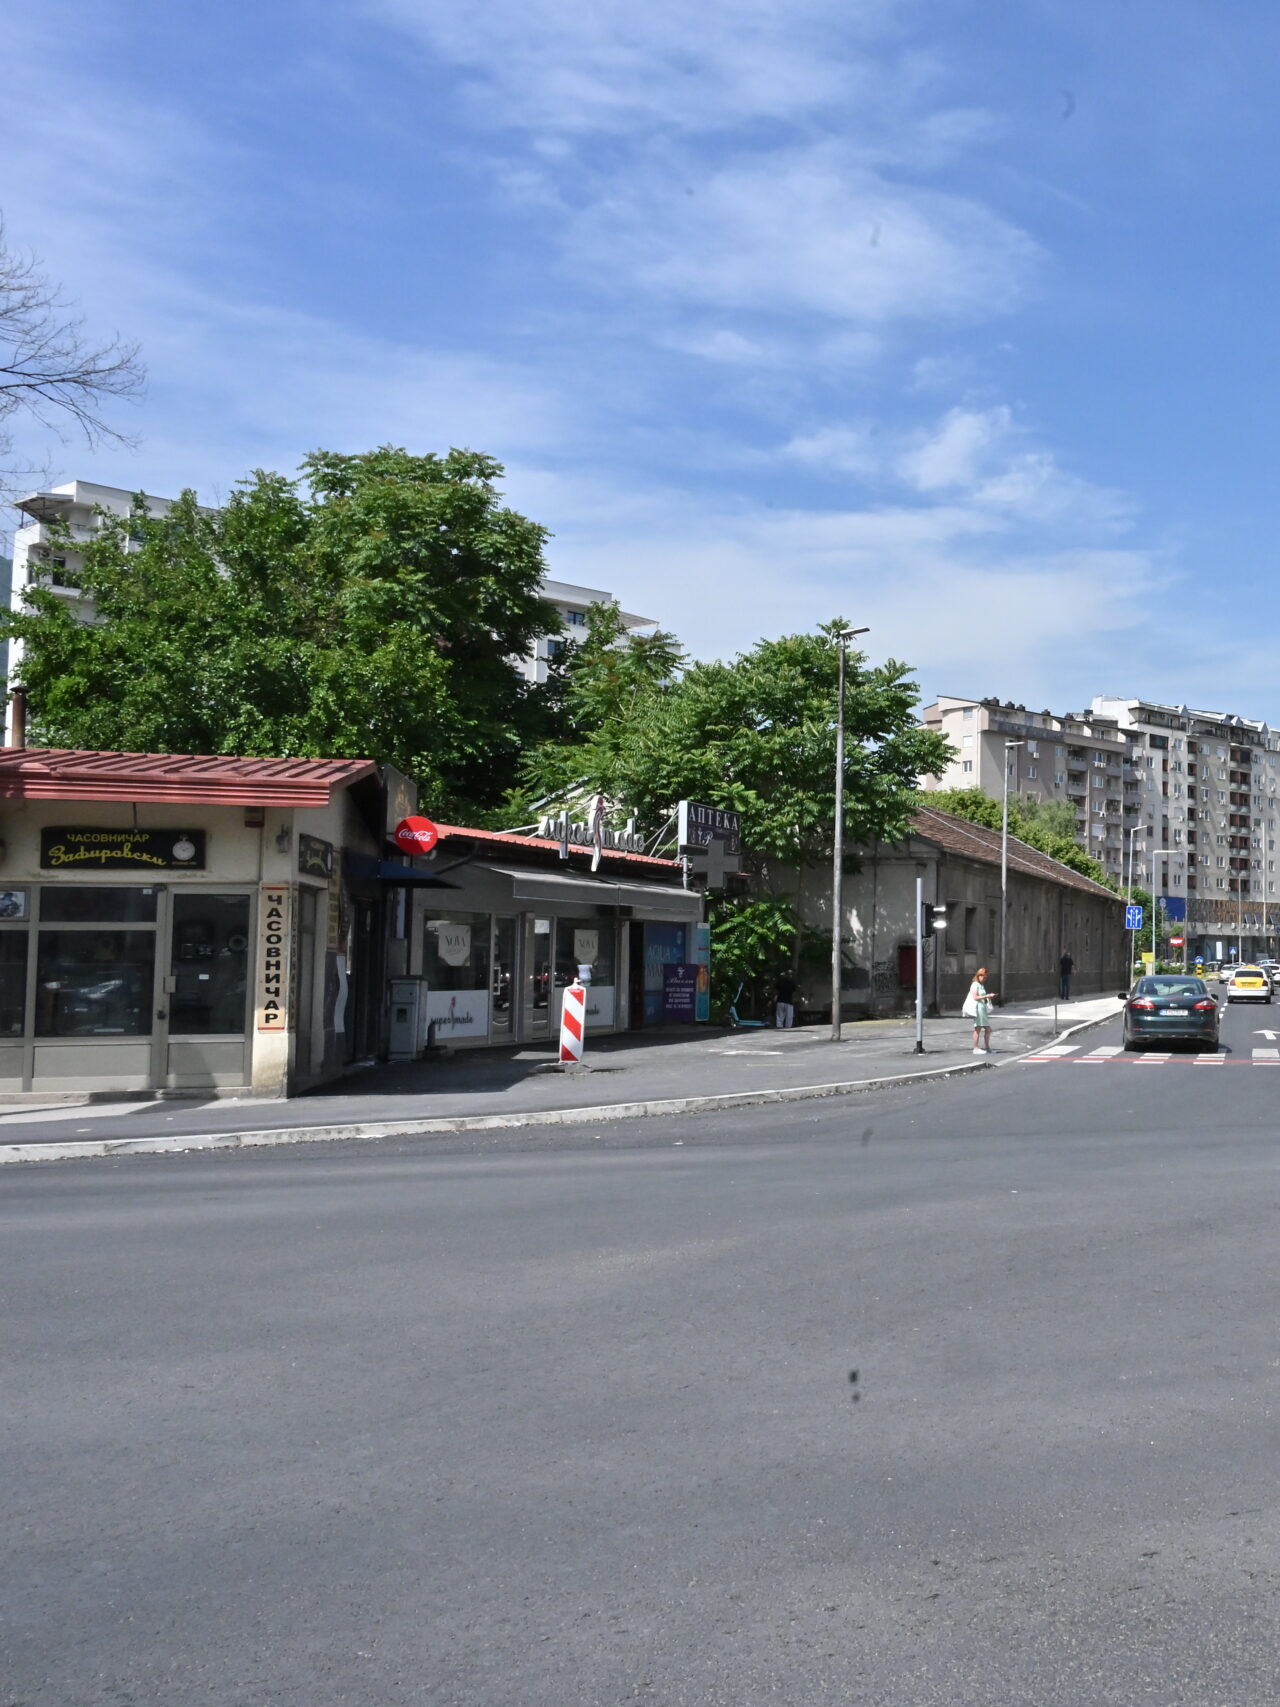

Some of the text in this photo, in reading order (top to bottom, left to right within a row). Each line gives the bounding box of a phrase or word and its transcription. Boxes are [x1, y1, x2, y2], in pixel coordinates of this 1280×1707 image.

[688, 805, 738, 831] АПТЕКА
[66, 833, 150, 843] ЧАСОВНИЧАР
[398, 828, 433, 842] Coca-Cola
[264, 895, 283, 1024] ЧАСОВНИЧАР
